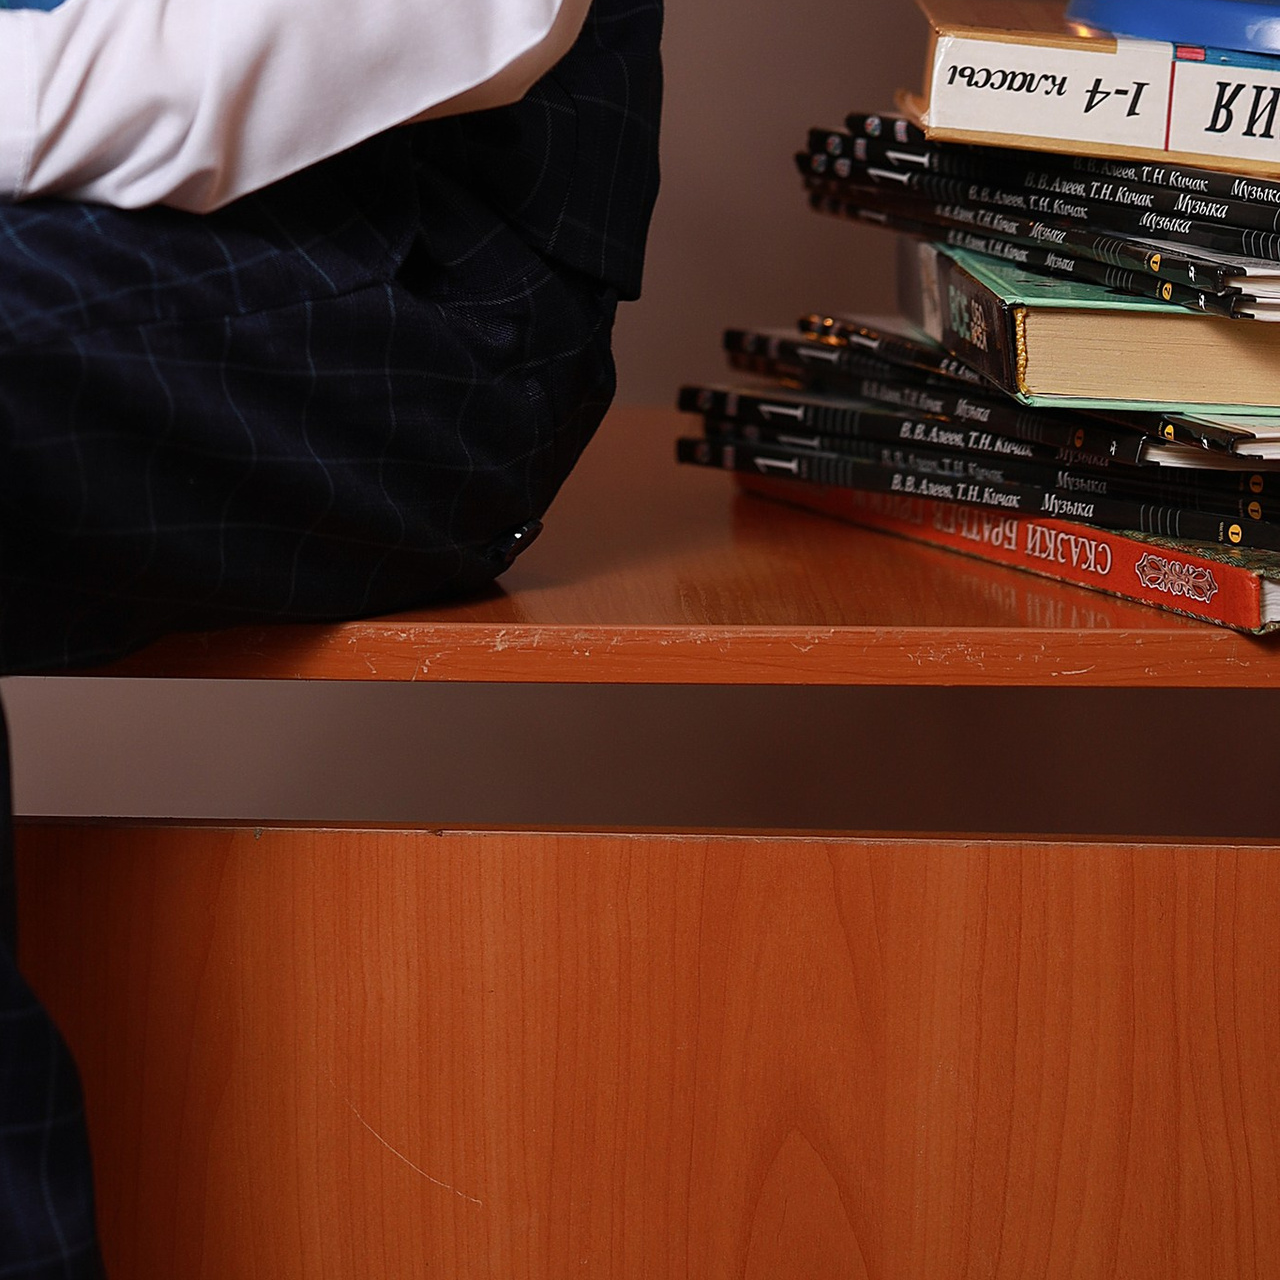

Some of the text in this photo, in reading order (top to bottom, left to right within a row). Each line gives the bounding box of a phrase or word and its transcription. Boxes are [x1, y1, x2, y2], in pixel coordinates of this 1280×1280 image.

[947, 65, 1150, 117] 1-4 классы
[1204, 81, 1280, 139] ИЯ
[1115, 186, 1155, 209] Кичак
[1173, 193, 1229, 218] Музыка
[1169, 171, 1209, 193] Кичак
[1025, 523, 1112, 576] СКАЗКИ
